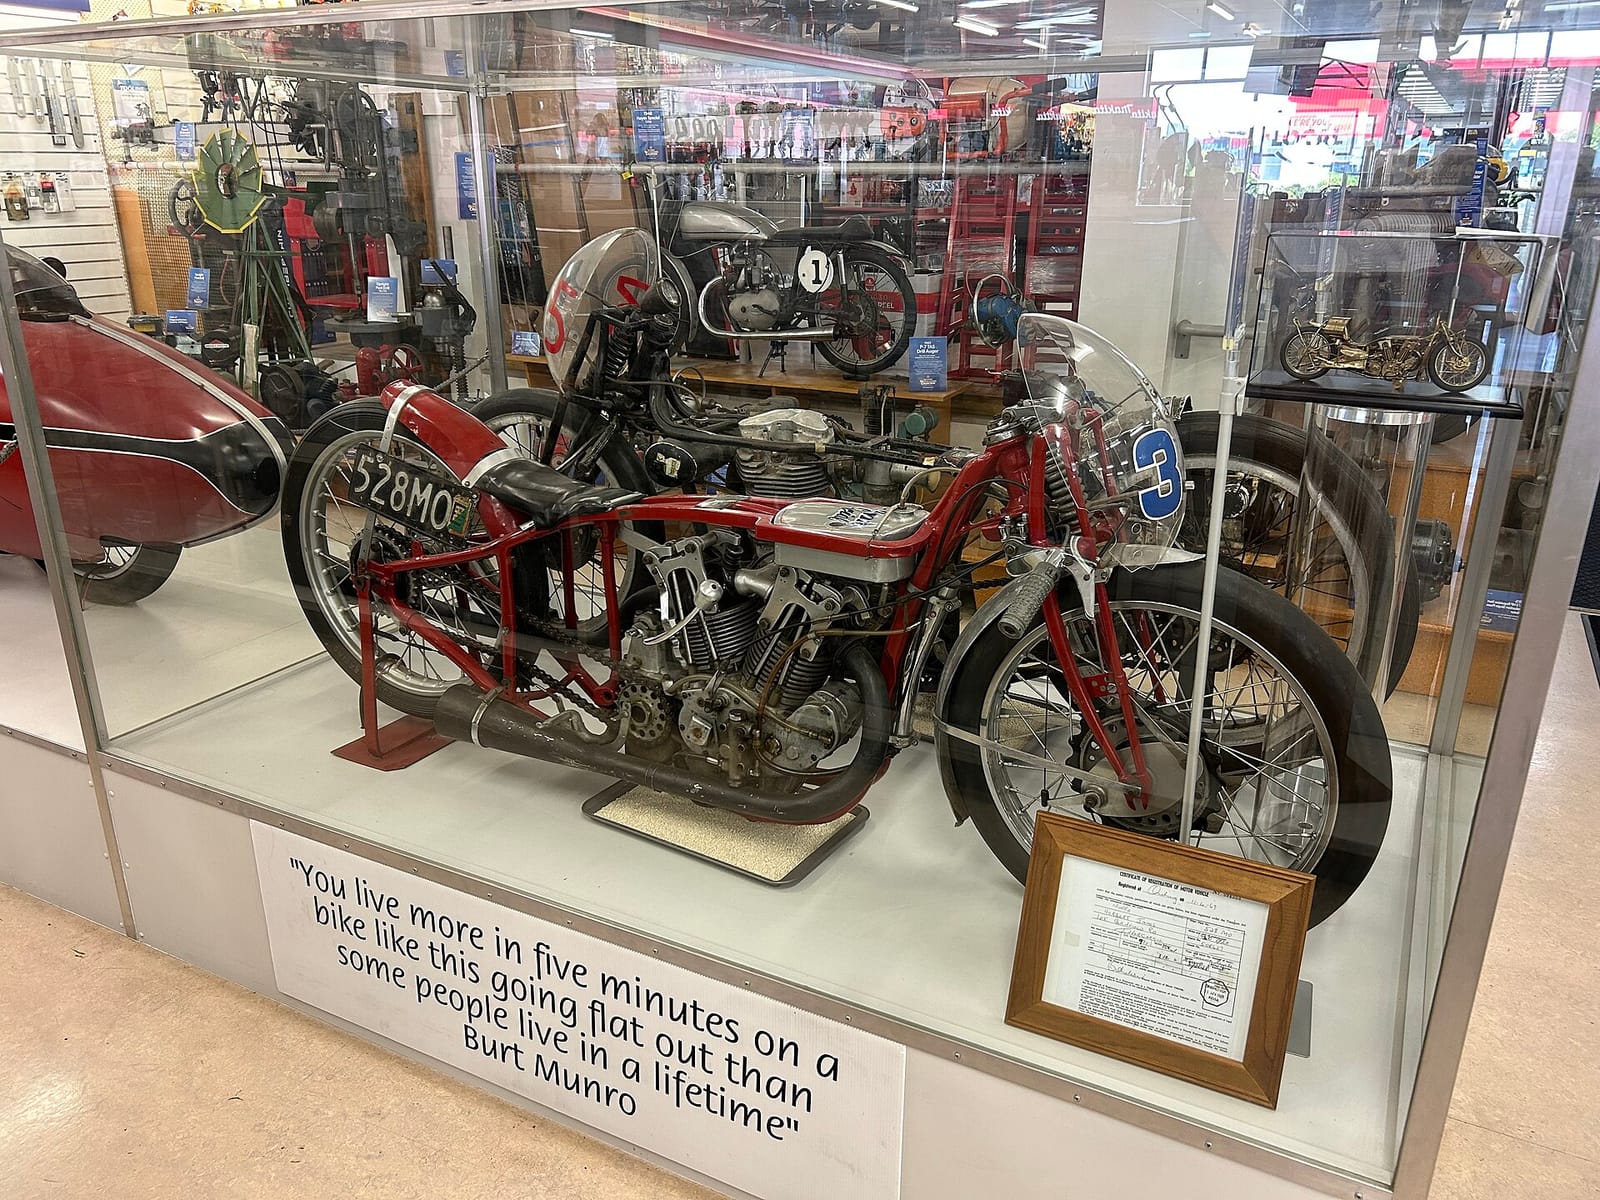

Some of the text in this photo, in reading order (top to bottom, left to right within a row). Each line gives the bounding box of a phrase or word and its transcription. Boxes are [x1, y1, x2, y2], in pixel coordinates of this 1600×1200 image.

[811, 259, 823, 285] 1
[1133, 428, 1182, 520] 3
[1120, 871, 1141, 881] CERTIFICATE
[1148, 878, 1173, 889] REGISTRATION
[290, 857, 839, 1081] "You live more in five minutes on a
[314, 896, 812, 1113] bike like this going flat out than
[337, 945, 800, 1141] some people live in a lifetime"
[463, 1024, 637, 1116] Burt Munro
